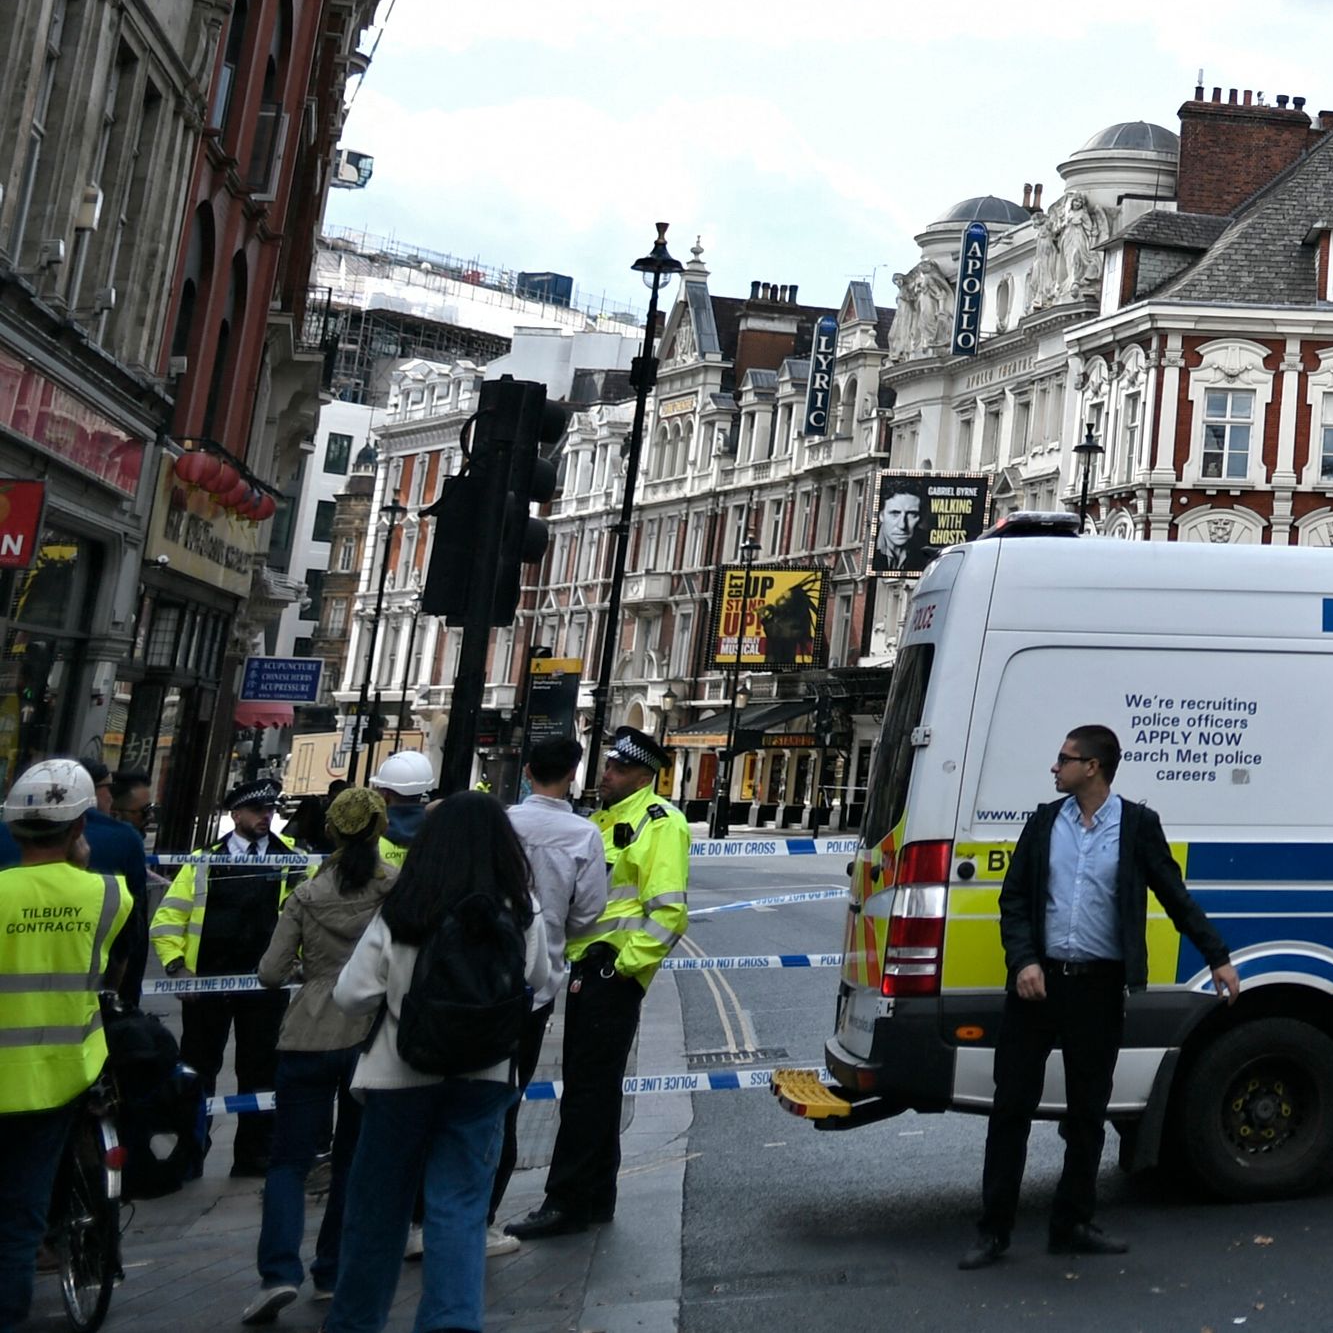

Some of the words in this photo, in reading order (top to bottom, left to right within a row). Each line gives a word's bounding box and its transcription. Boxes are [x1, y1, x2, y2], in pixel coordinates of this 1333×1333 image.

[957, 241, 982, 349] APOLLO
[966, 369, 994, 389] APOLLO
[998, 356, 1033, 379] THEATRE
[809, 336, 835, 428] LYRIC
[928, 486, 955, 497] GABRIEL
[956, 487, 979, 497] BYRNE
[931, 498, 972, 514] WALKING
[937, 514, 962, 529] WITH
[929, 530, 967, 545] GHOSTS
[727, 573, 745, 599] GET
[746, 576, 774, 599] UP
[720, 644, 760, 655] MUSICAL
[263, 662, 317, 671] ACUPUNCTURE
[260, 683, 310, 693] ACUPRESSURE
[1125, 694, 1174, 709] We're
[1180, 697, 1257, 715] recruiting
[1131, 712, 1180, 729] police
[1187, 714, 1248, 729] officers
[1135, 730, 1192, 745] APPLY
[1198, 732, 1243, 746] NOW
[1122, 749, 1169, 763] earch
[1176, 749, 1208, 764] Met
[1214, 750, 1262, 767] police
[1156, 769, 1217, 782] careers
[708, 843, 722, 855] DO
[723, 842, 742, 855] NOT
[745, 841, 776, 854] CROSS
[826, 841, 859, 853] POLICE
[169, 854, 206, 863] POLICE
[208, 854, 231, 864] LINE
[234, 854, 248, 863] DO
[250, 854, 271, 864] NOT
[274, 854, 309, 864] CROSS
[22, 907, 82, 918] TILBURY
[6, 921, 92, 934] CONTRACTS
[677, 957, 699, 970] LINE
[700, 957, 714, 969] DO
[716, 957, 735, 969] NOT
[737, 956, 769, 967] CROSS
[154, 978, 192, 993] POLICE
[194, 978, 218, 991] LINE
[220, 977, 235, 990] DO
[238, 976, 259, 989] NOT
[624, 1078, 638, 1093] DO
[639, 1077, 661, 1092] LINE
[663, 1074, 698, 1091] POLICE
